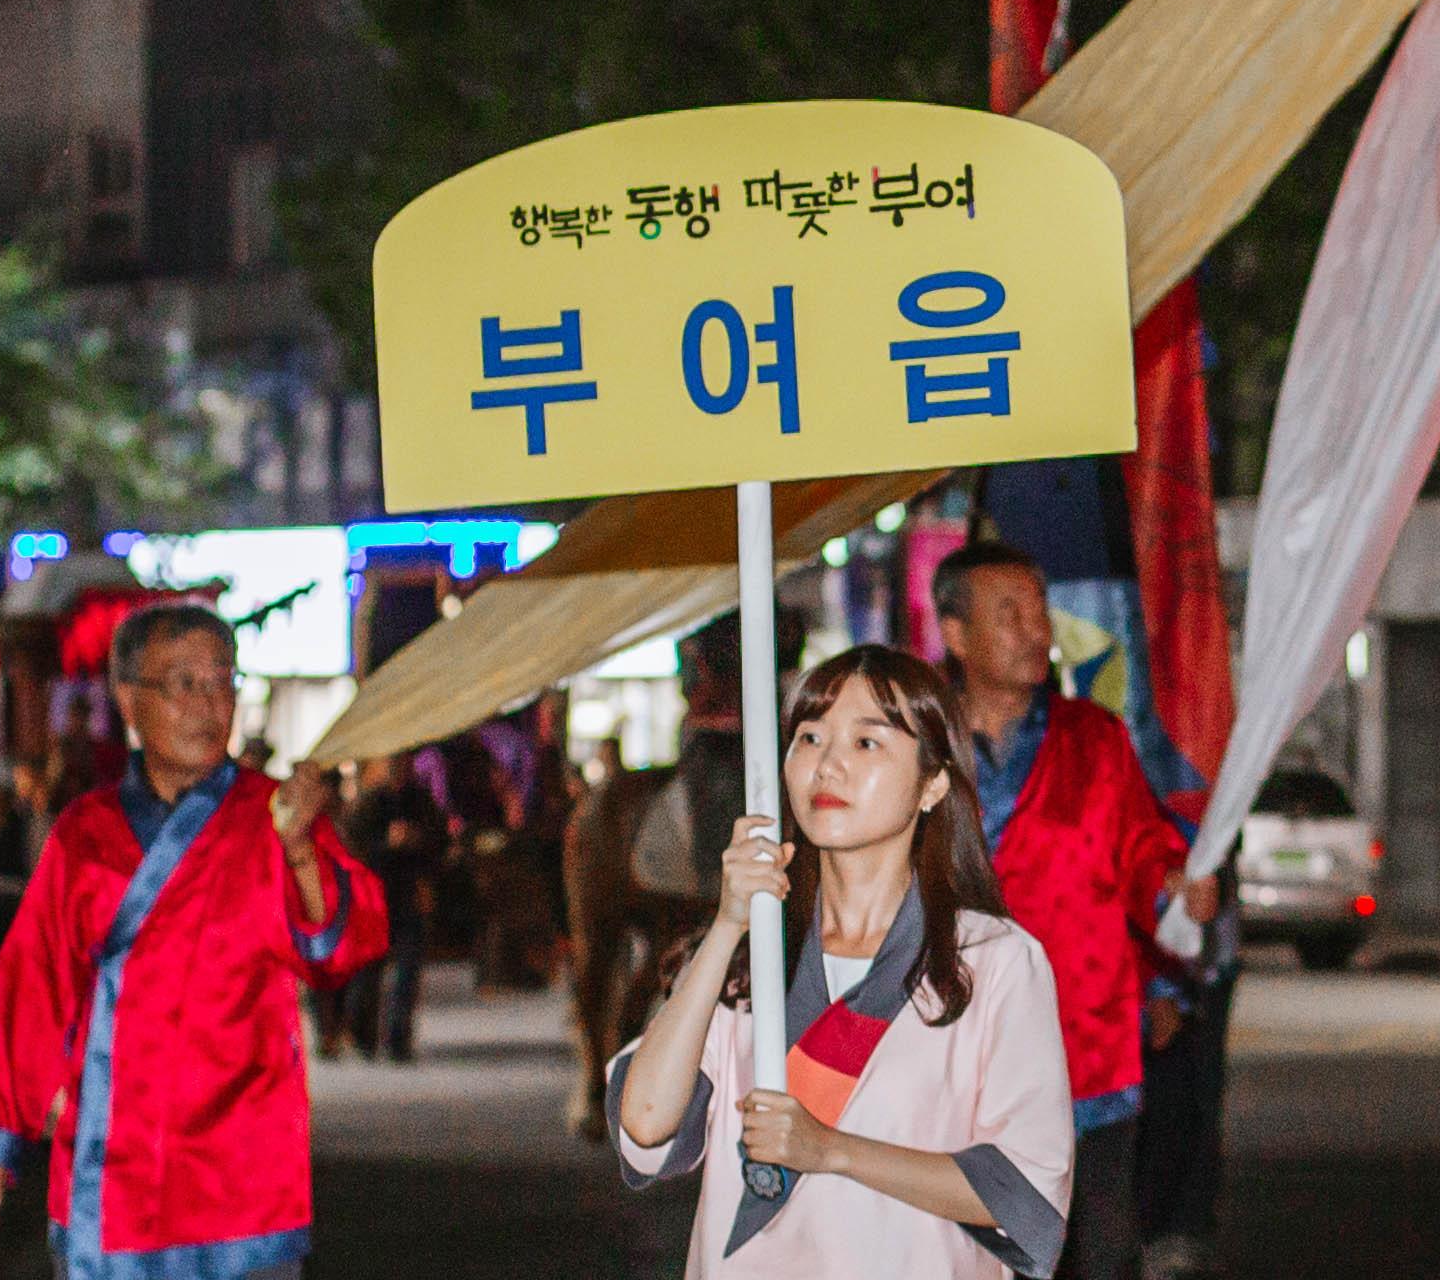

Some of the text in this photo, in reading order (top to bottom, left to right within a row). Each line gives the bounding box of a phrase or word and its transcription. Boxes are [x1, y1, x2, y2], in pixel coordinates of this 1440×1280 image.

[508, 161, 976, 250] 행복한 동행 따뜻한 부여
[471, 270, 1021, 455] 부여읍
